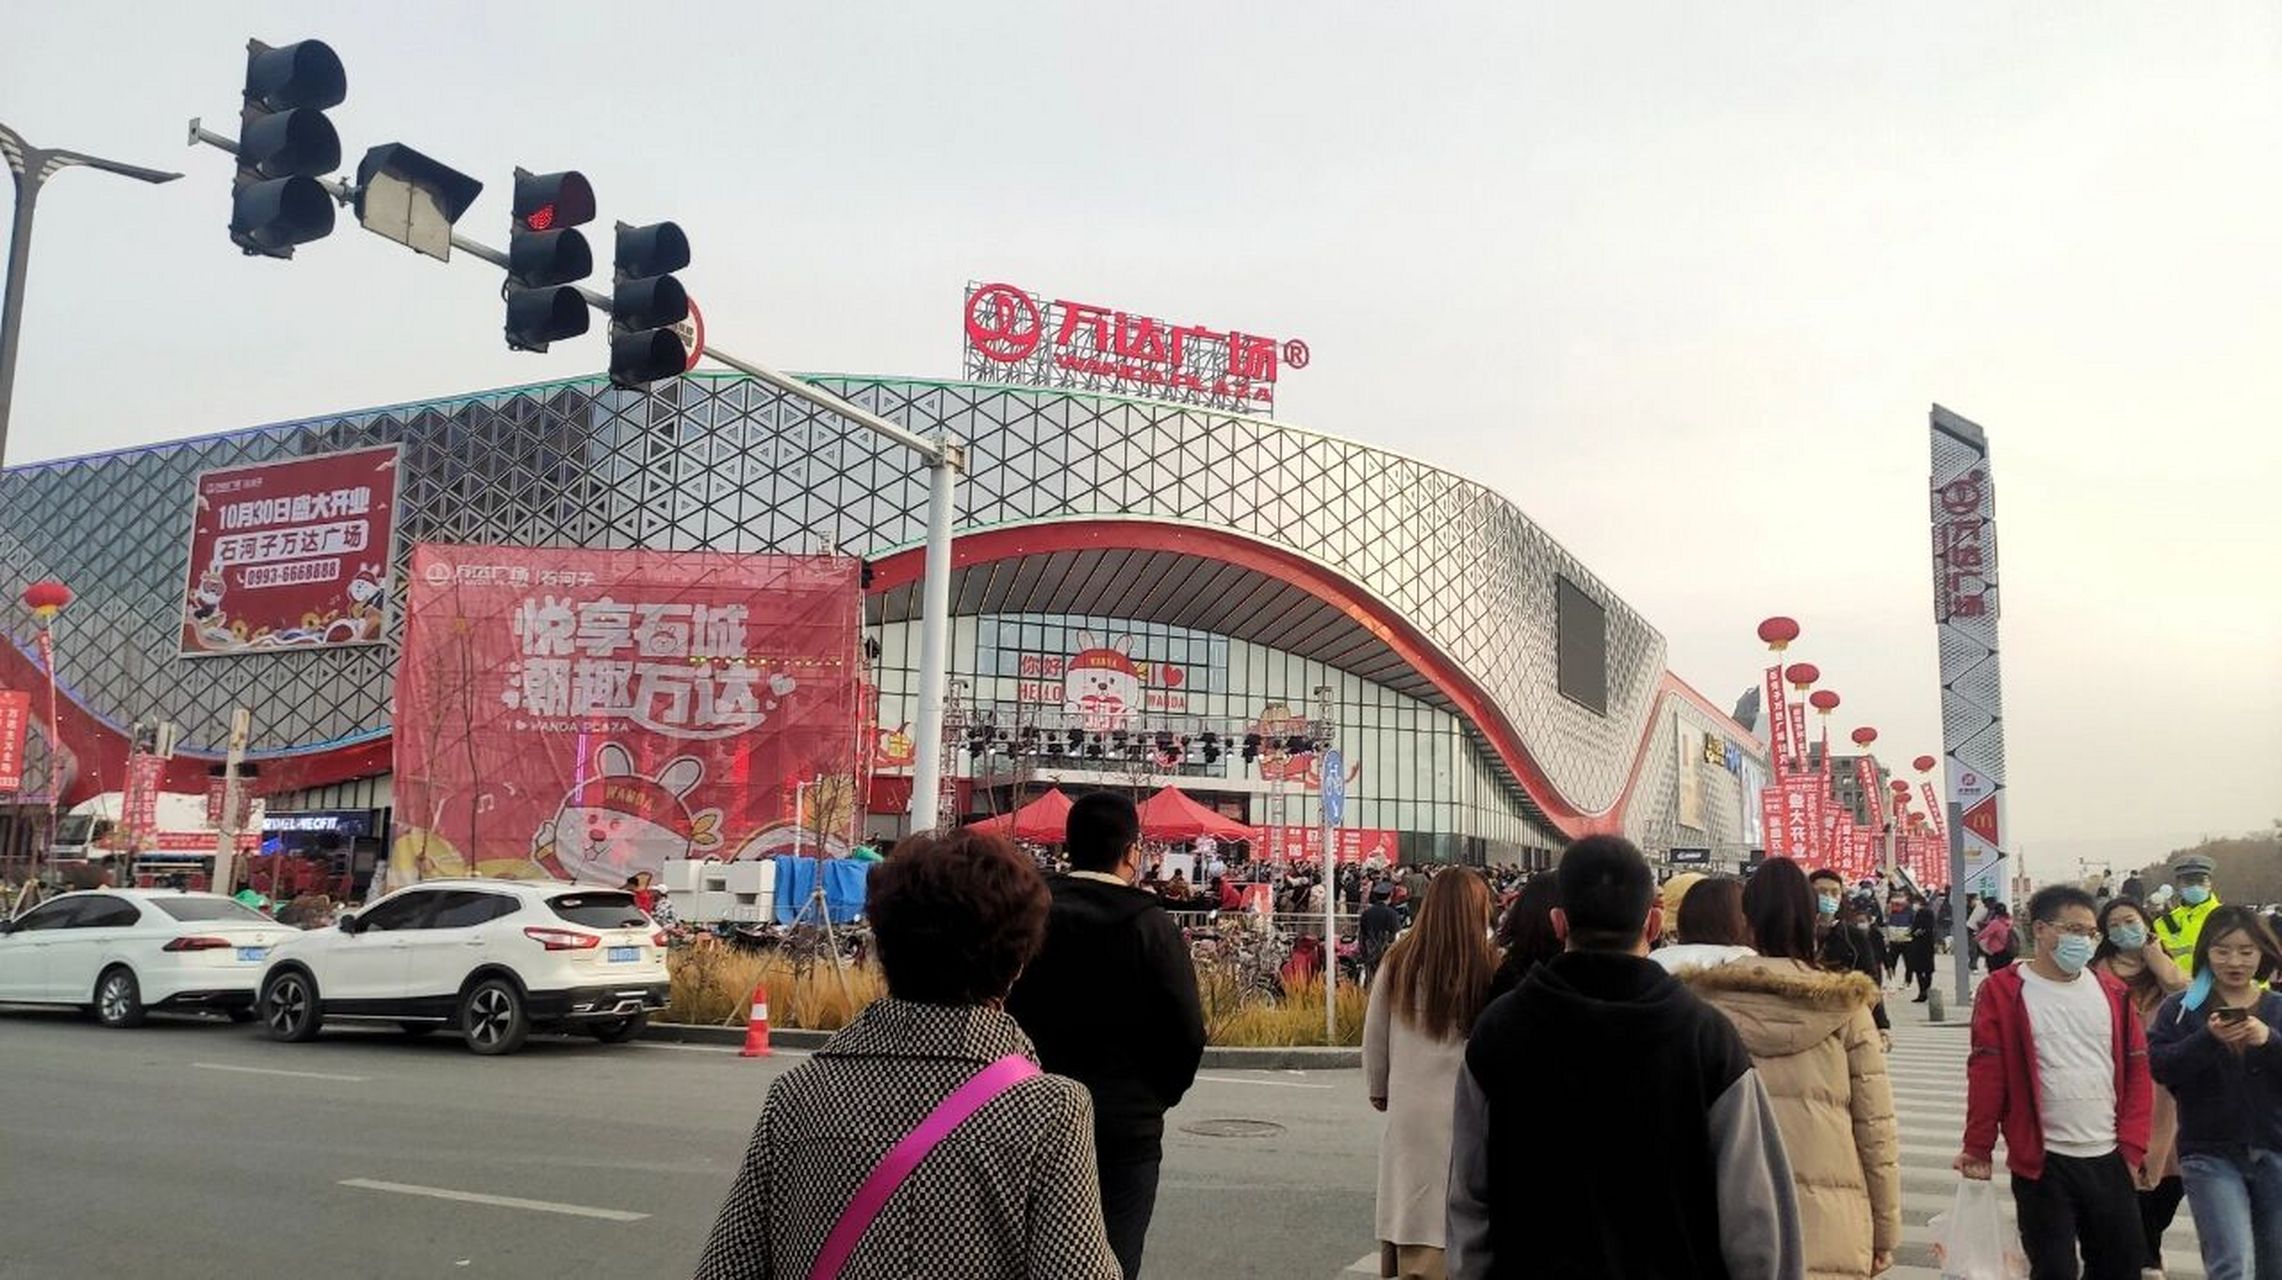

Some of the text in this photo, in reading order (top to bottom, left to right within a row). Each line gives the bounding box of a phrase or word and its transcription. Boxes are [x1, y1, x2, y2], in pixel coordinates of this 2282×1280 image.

[1055, 299, 1277, 383] 万达广场
[218, 486, 371, 530] 10月30日盛大开业
[220, 523, 363, 562] 石河子万达广场
[513, 595, 750, 659] 悦享石城
[1021, 655, 1063, 676] 你好
[502, 657, 768, 740] 潮趣万达
[1020, 683, 1062, 701] HELLO
[1147, 694, 1186, 710] WANDA
